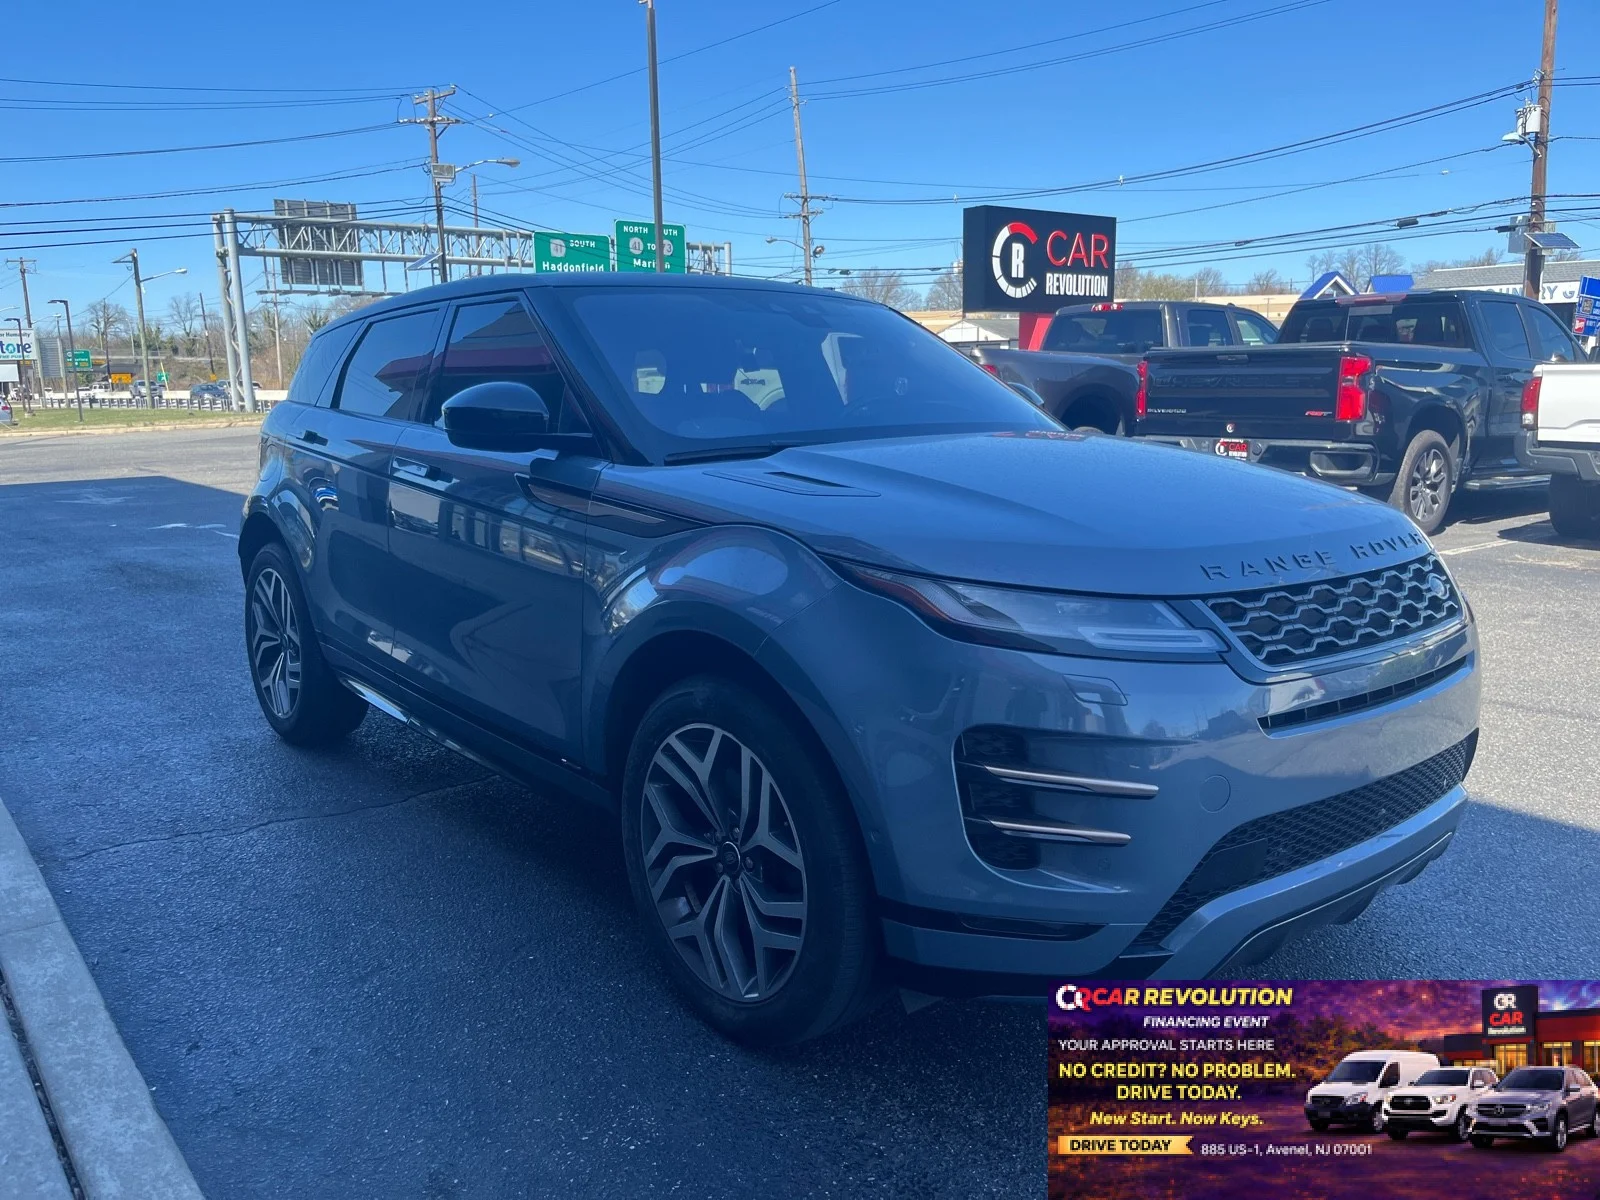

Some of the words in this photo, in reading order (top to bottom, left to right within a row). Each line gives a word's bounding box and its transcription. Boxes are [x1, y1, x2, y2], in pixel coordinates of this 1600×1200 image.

[623, 225, 648, 234] NORTH
[663, 228, 678, 236] UTH
[569, 240, 596, 249] SOUTH
[631, 241, 641, 251] 41
[647, 243, 656, 251] TO
[1046, 230, 1109, 269] CAR
[542, 261, 604, 273] Haddonfield
[1045, 273, 1109, 297] REVOLUTION
[1200, 550, 1337, 581] RANGE
[1350, 532, 1425, 560] ROVER
